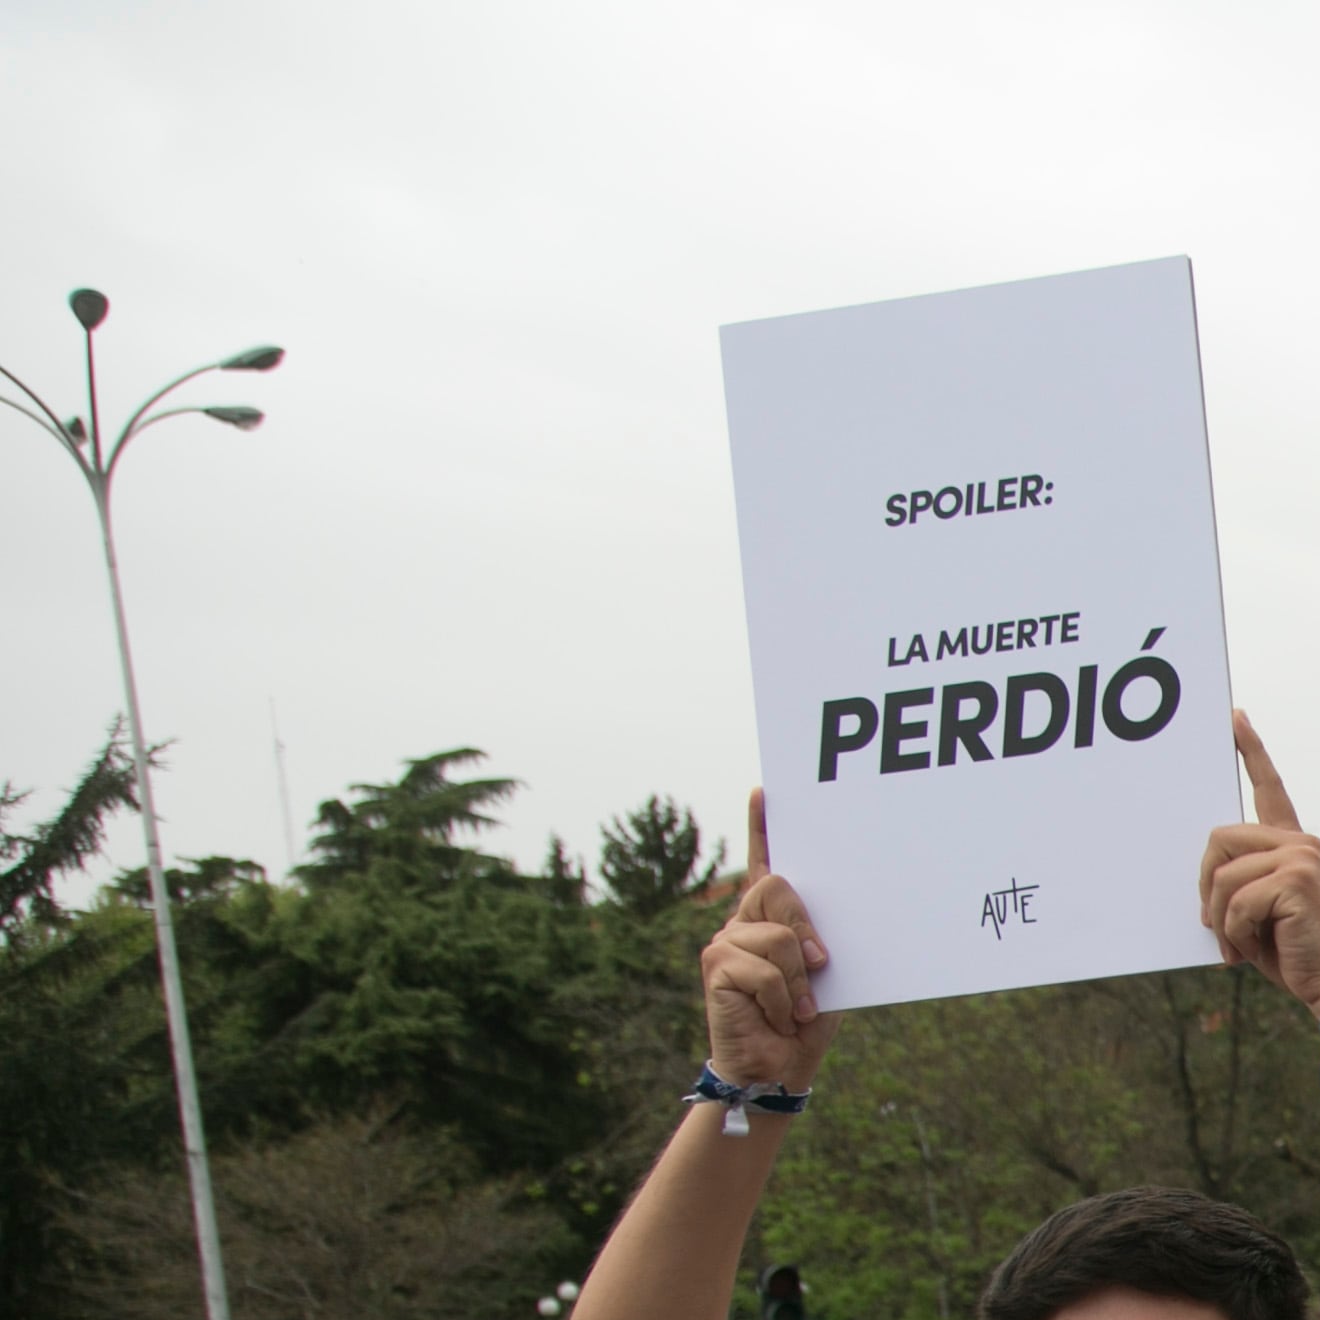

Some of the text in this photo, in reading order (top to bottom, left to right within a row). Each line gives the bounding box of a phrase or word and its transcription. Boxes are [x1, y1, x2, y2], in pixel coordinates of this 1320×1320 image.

[885, 474, 1054, 527] SPOILER:
[886, 611, 1082, 667] LA MUERTE
[817, 625, 1182, 783] PERDIÓ
